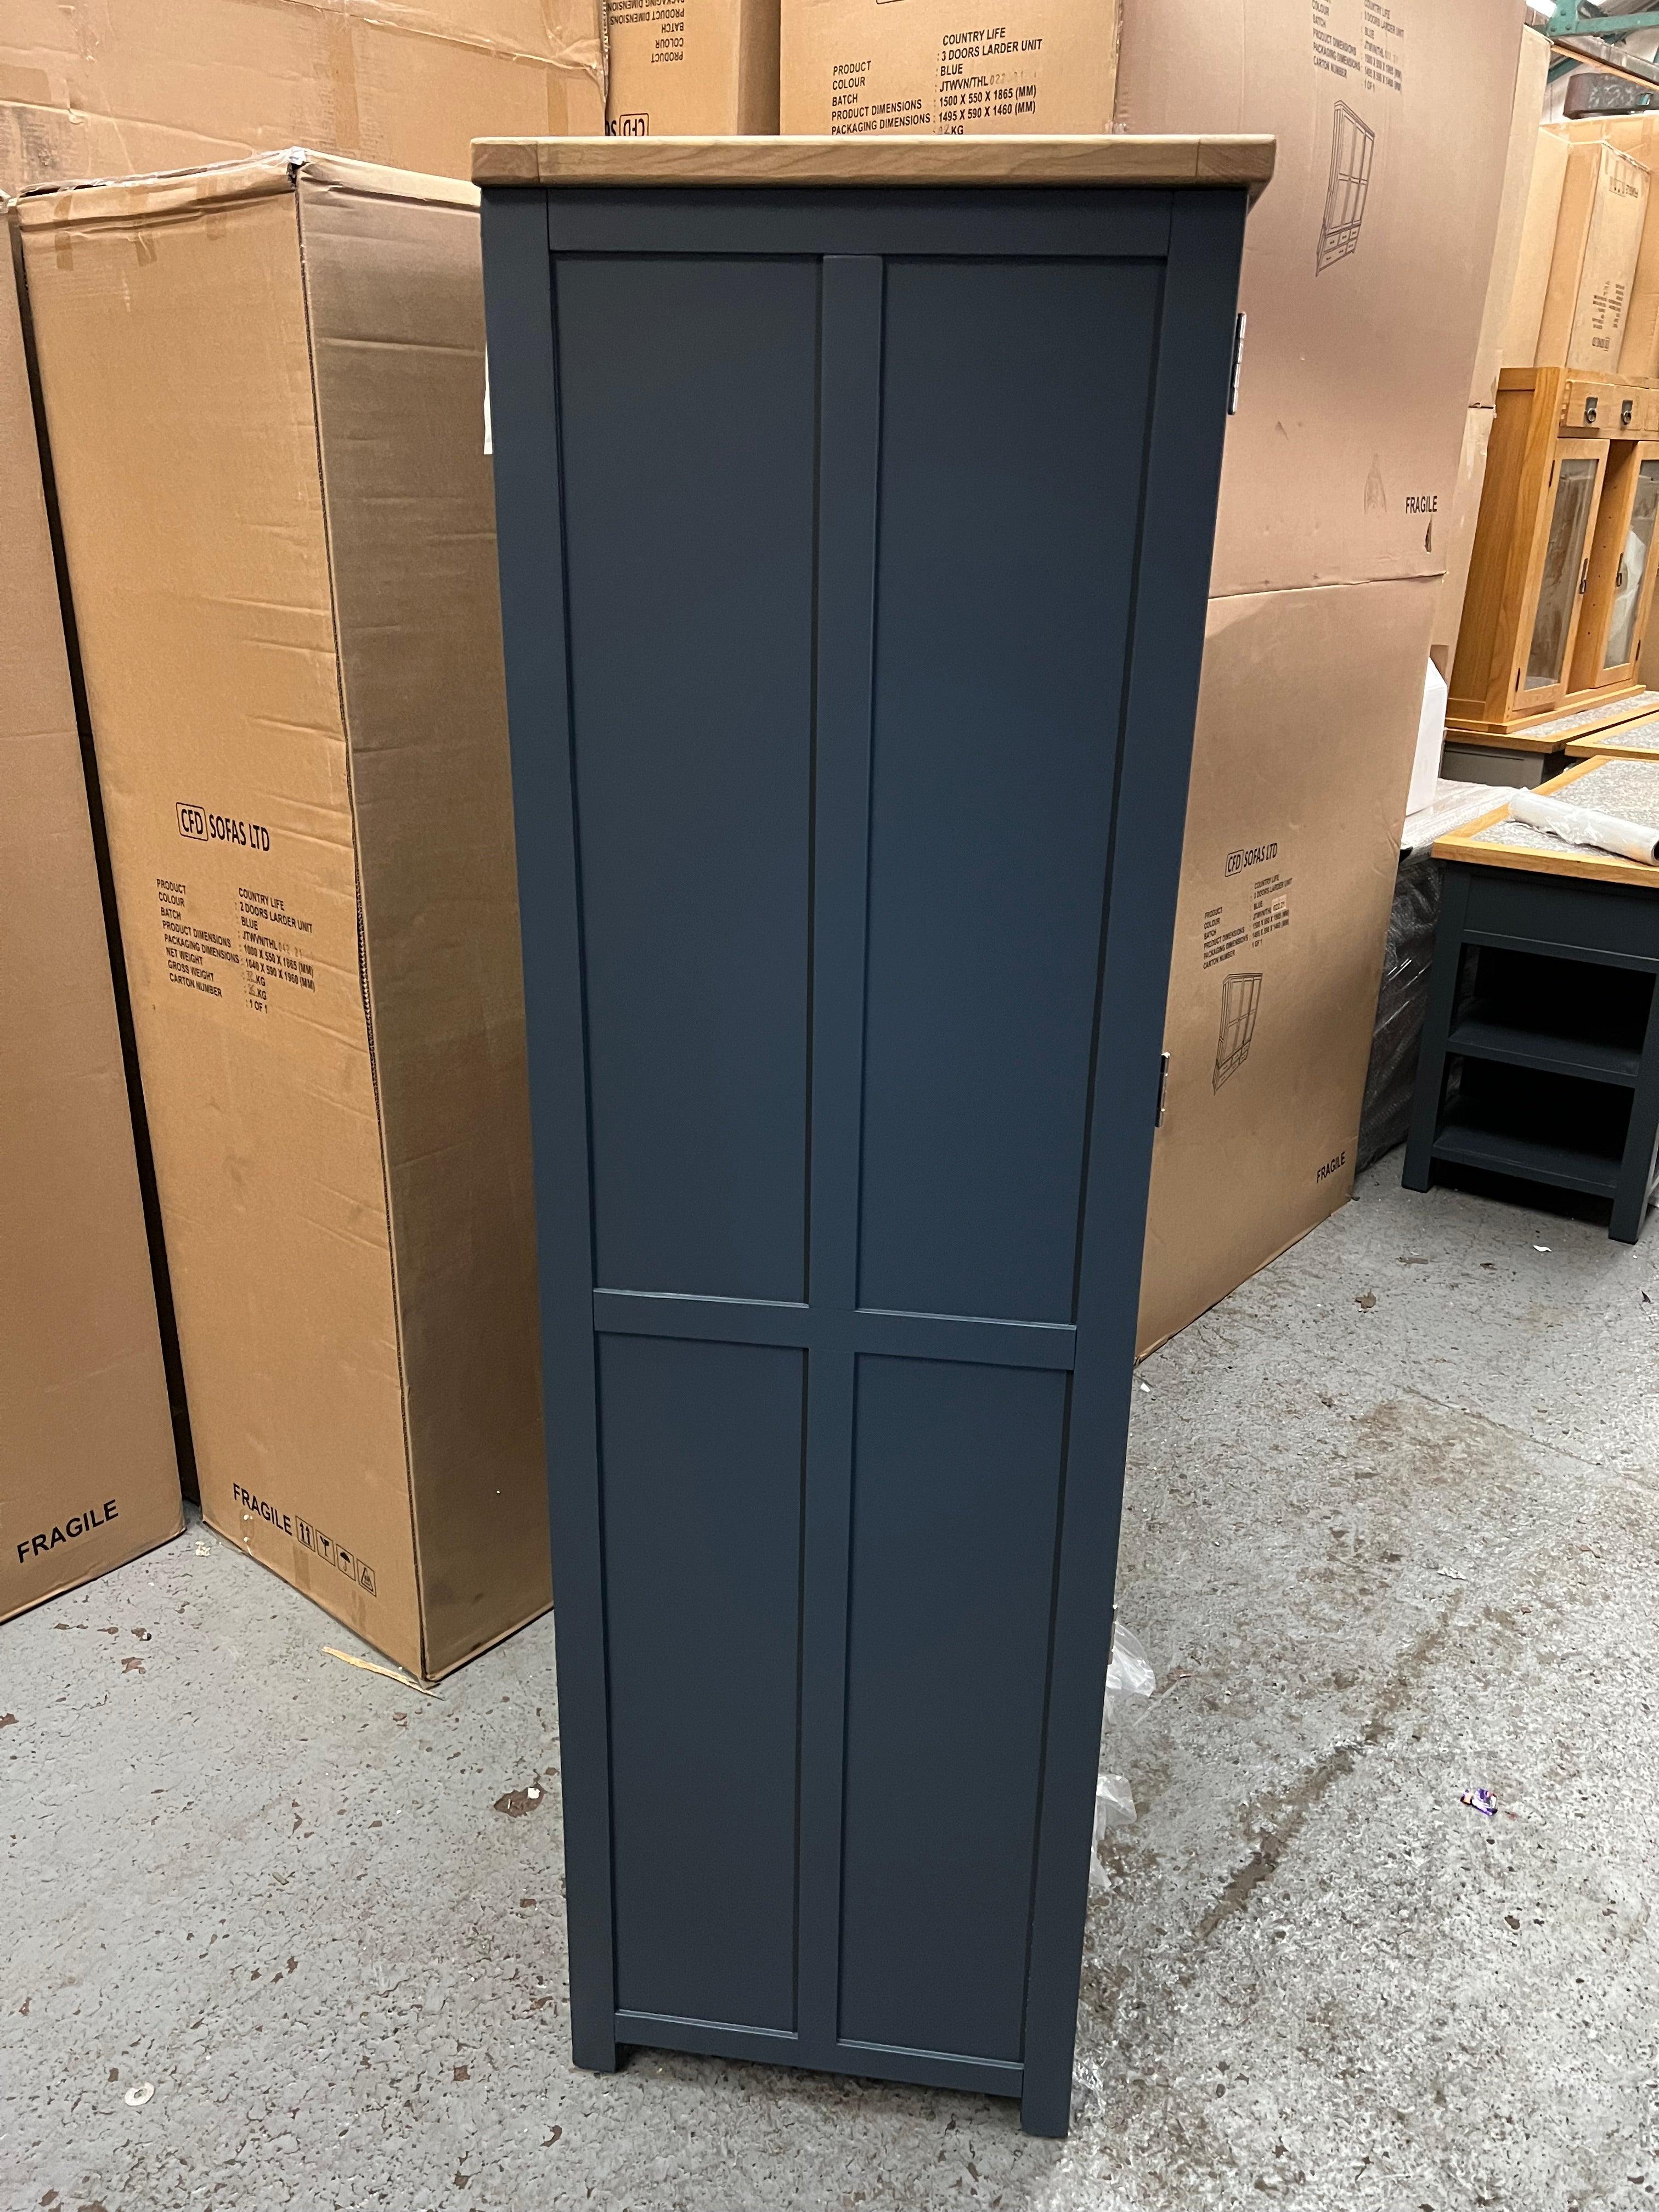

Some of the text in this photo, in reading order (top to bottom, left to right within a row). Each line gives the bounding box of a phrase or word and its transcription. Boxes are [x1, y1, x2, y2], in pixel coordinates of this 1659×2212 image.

[610, 8, 685, 25] PRODUCT DIMENSIONS
[662, 22, 684, 33] BATCH
[656, 37, 684, 48] COLOUR
[943, 27, 1006, 46] COUNTRY LIFE
[651, 52, 684, 63] PRODUCT
[941, 39, 1042, 61] 3 DOORS LARDER UNIT
[833, 60, 871, 76] PRODUCT
[940, 63, 963, 76] BLUE
[832, 76, 865, 91] COLOUR
[940, 76, 989, 92] JTWVN/THL
[832, 93, 858, 106] BATCH
[939, 85, 1036, 107] 1500 X 550 X 1865 (MM)
[832, 99, 922, 121] PRODUCT DIMENSIONS
[939, 100, 1036, 122] 1495 X 590 X 1460 (MM)
[623, 119, 645, 136] CFD
[832, 113, 930, 135] PACKAGING DIMENSIONS
[951, 125, 963, 134] KG
[1406, 495, 1437, 514] FRAGILE
[181, 808, 270, 851] CFD SOFAS LTD
[1228, 842, 1277, 873] CFD SOFAS LTD
[157, 878, 186, 895] PRODUCT
[159, 892, 185, 907] COLOUR
[239, 888, 285, 911] COUNTRY LIFE
[160, 907, 182, 921] BATCH
[240, 901, 312, 933] 2 DOORS LARDER UNIT
[1204, 906, 1223, 919] PRODUCT
[241, 916, 258, 930] BLUE
[1204, 917, 1220, 929] COLOUR
[162, 920, 231, 948] PRODUCT DIMENSIONS
[1204, 928, 1216, 940] BATCH
[1204, 936, 1222, 950] PRODUCT
[1222, 926, 1245, 941] DIMENSIONS
[164, 934, 240, 964] PACKAGING DIMENSIONS
[166, 947, 202, 966] NET WEIGHT
[1204, 944, 1225, 960] PACKAGING
[244, 944, 314, 979] 1000 X 550 X 1865 (MM)
[1203, 957, 1218, 969] CARTON
[168, 960, 213, 981] GROSS WEIGHT
[246, 958, 315, 993] 1040 X 590 X 1960 (MM)
[170, 973, 222, 998] CARTON NUMBER
[256, 974, 266, 986] KG
[257, 988, 267, 1000] KG
[250, 999, 268, 1014] 1 OF 1
[1317, 1151, 1345, 1183] FRAGILE
[233, 1482, 292, 1536] FRAGILE
[17, 1499, 119, 1564] FRAGILE
